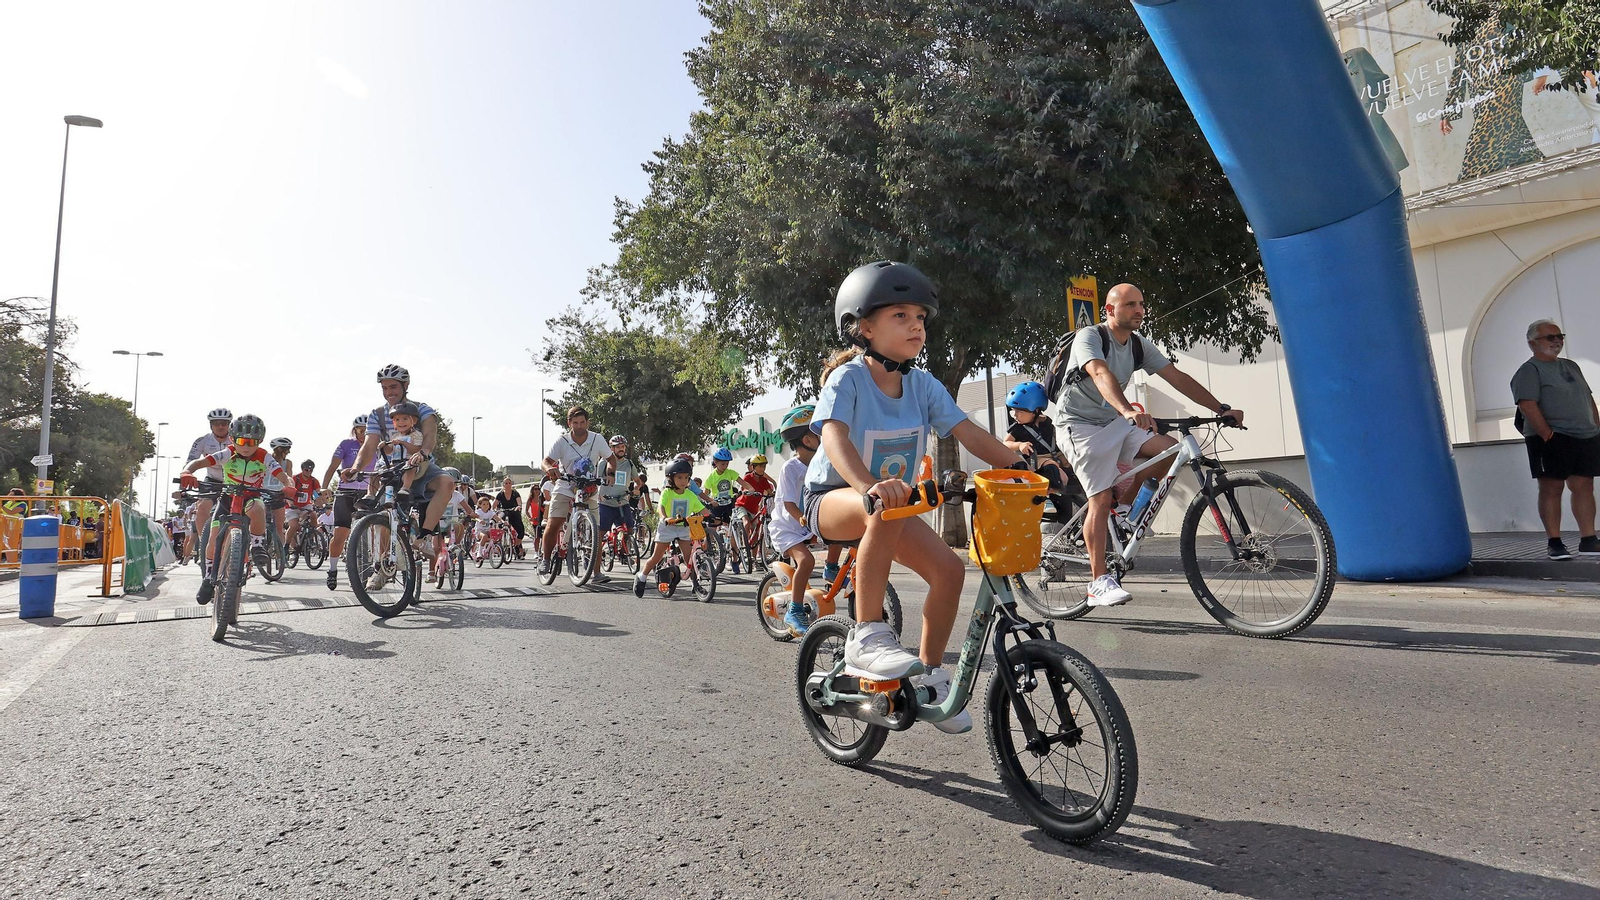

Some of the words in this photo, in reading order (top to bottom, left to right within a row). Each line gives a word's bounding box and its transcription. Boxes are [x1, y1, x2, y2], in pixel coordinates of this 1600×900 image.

[1435, 55, 1461, 75] EL
[1444, 69, 1474, 91] LA
[1427, 105, 1455, 119] Corte
[728, 428, 758, 451] Corte
[1135, 475, 1176, 541] ORBEA
